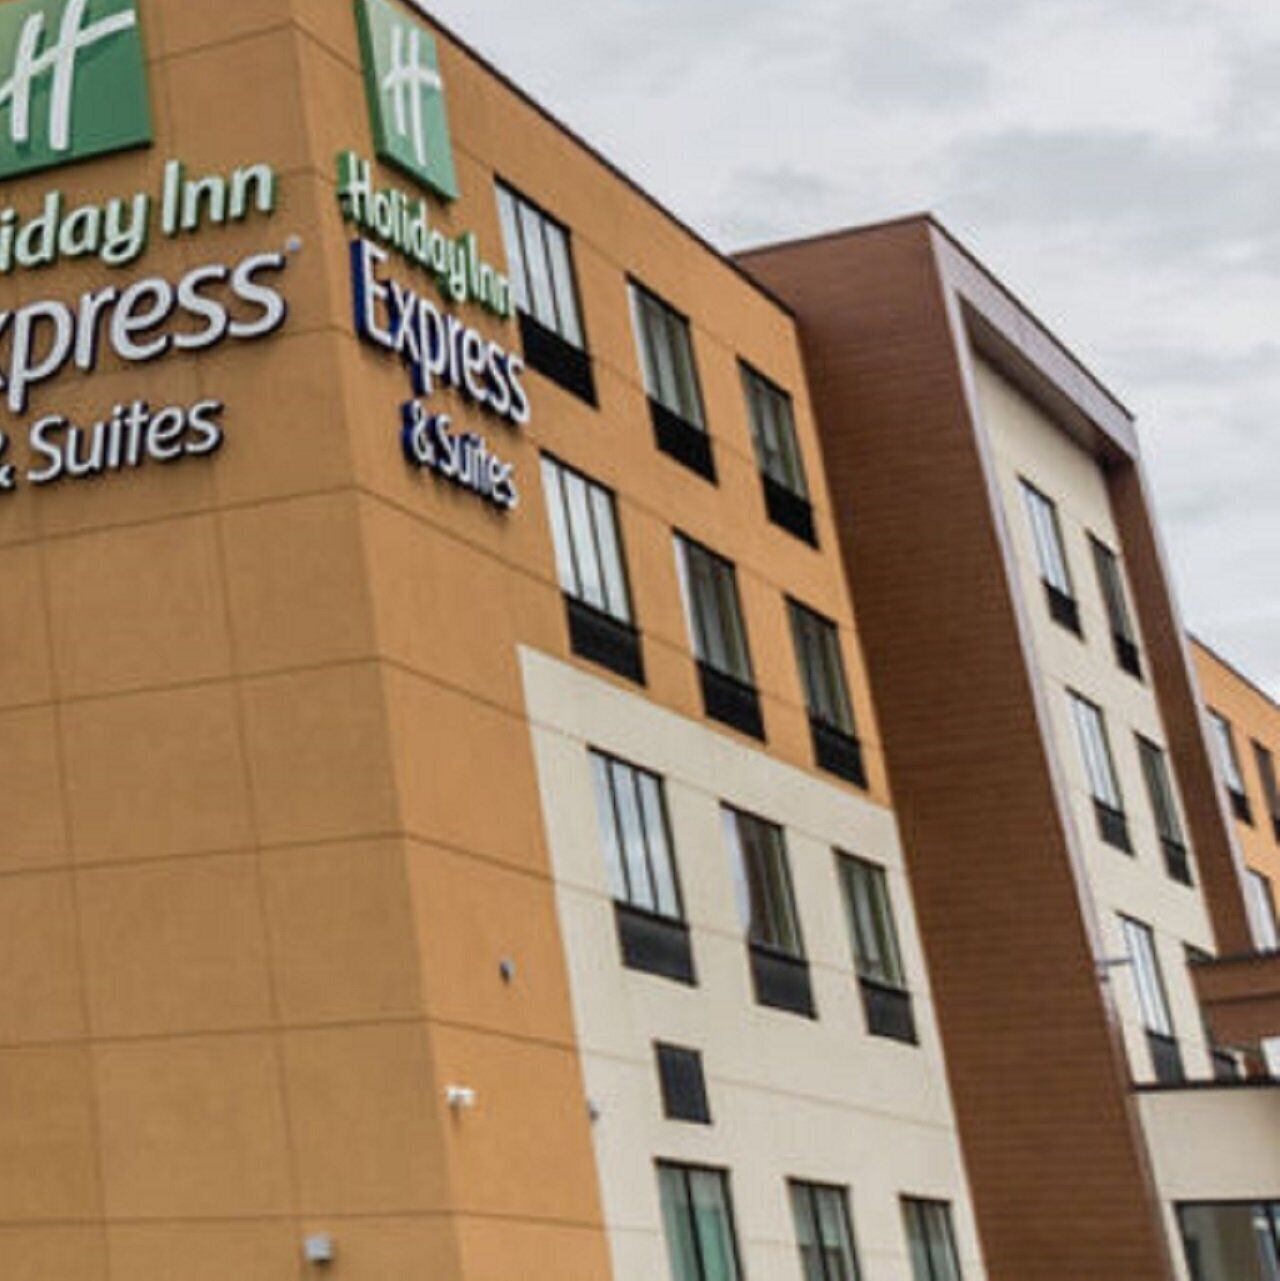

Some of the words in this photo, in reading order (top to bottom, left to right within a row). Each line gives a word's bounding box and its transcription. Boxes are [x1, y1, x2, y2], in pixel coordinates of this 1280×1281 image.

[160, 158, 278, 236] Inn
[340, 150, 467, 302] Holiday
[464, 231, 519, 319] Inn
[354, 238, 531, 423] Express
[26, 399, 226, 486] Suites
[406, 398, 434, 464] &
[434, 412, 519, 508] Suites
